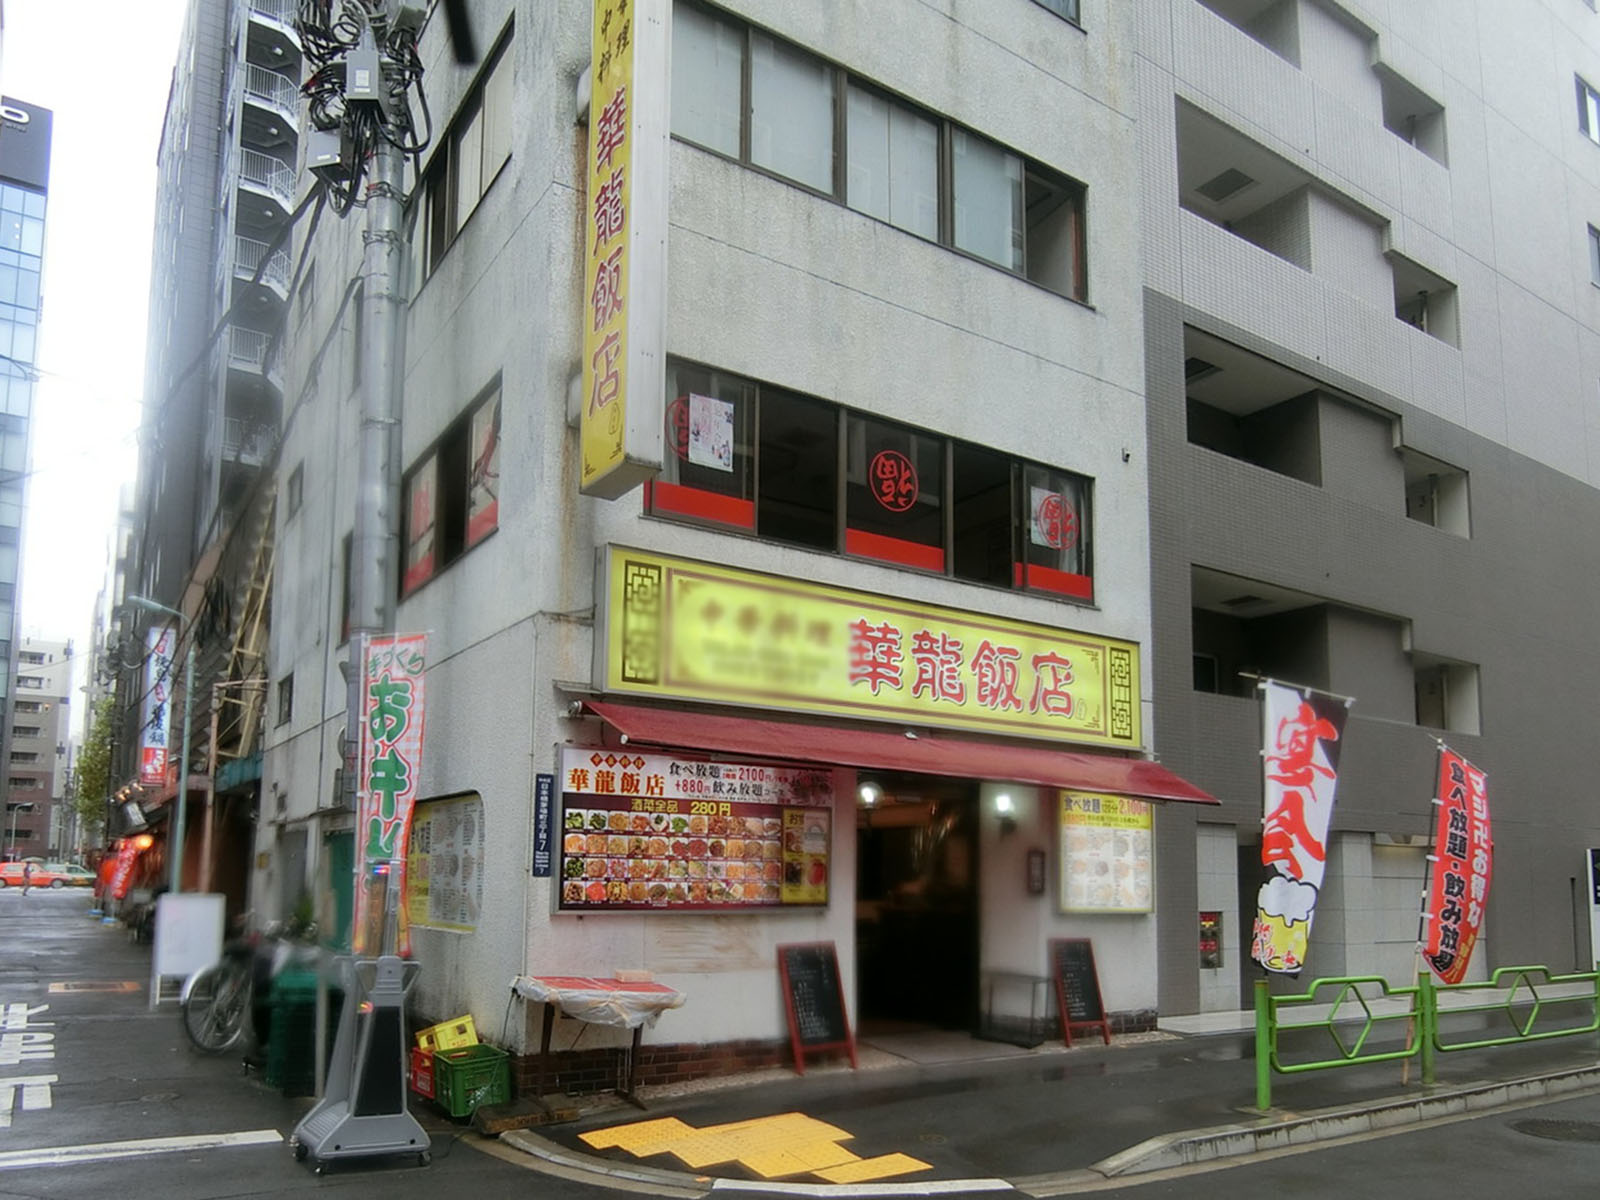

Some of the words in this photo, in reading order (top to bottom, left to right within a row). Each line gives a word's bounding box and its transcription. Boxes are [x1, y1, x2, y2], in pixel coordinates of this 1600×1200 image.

[588, 85, 627, 418] 華龍飯店
[849, 618, 1074, 717] 華龍飯店
[567, 768, 665, 797] 華龍飯店
[669, 762, 720, 779] 食べ放題
[690, 801, 731, 817] 280円
